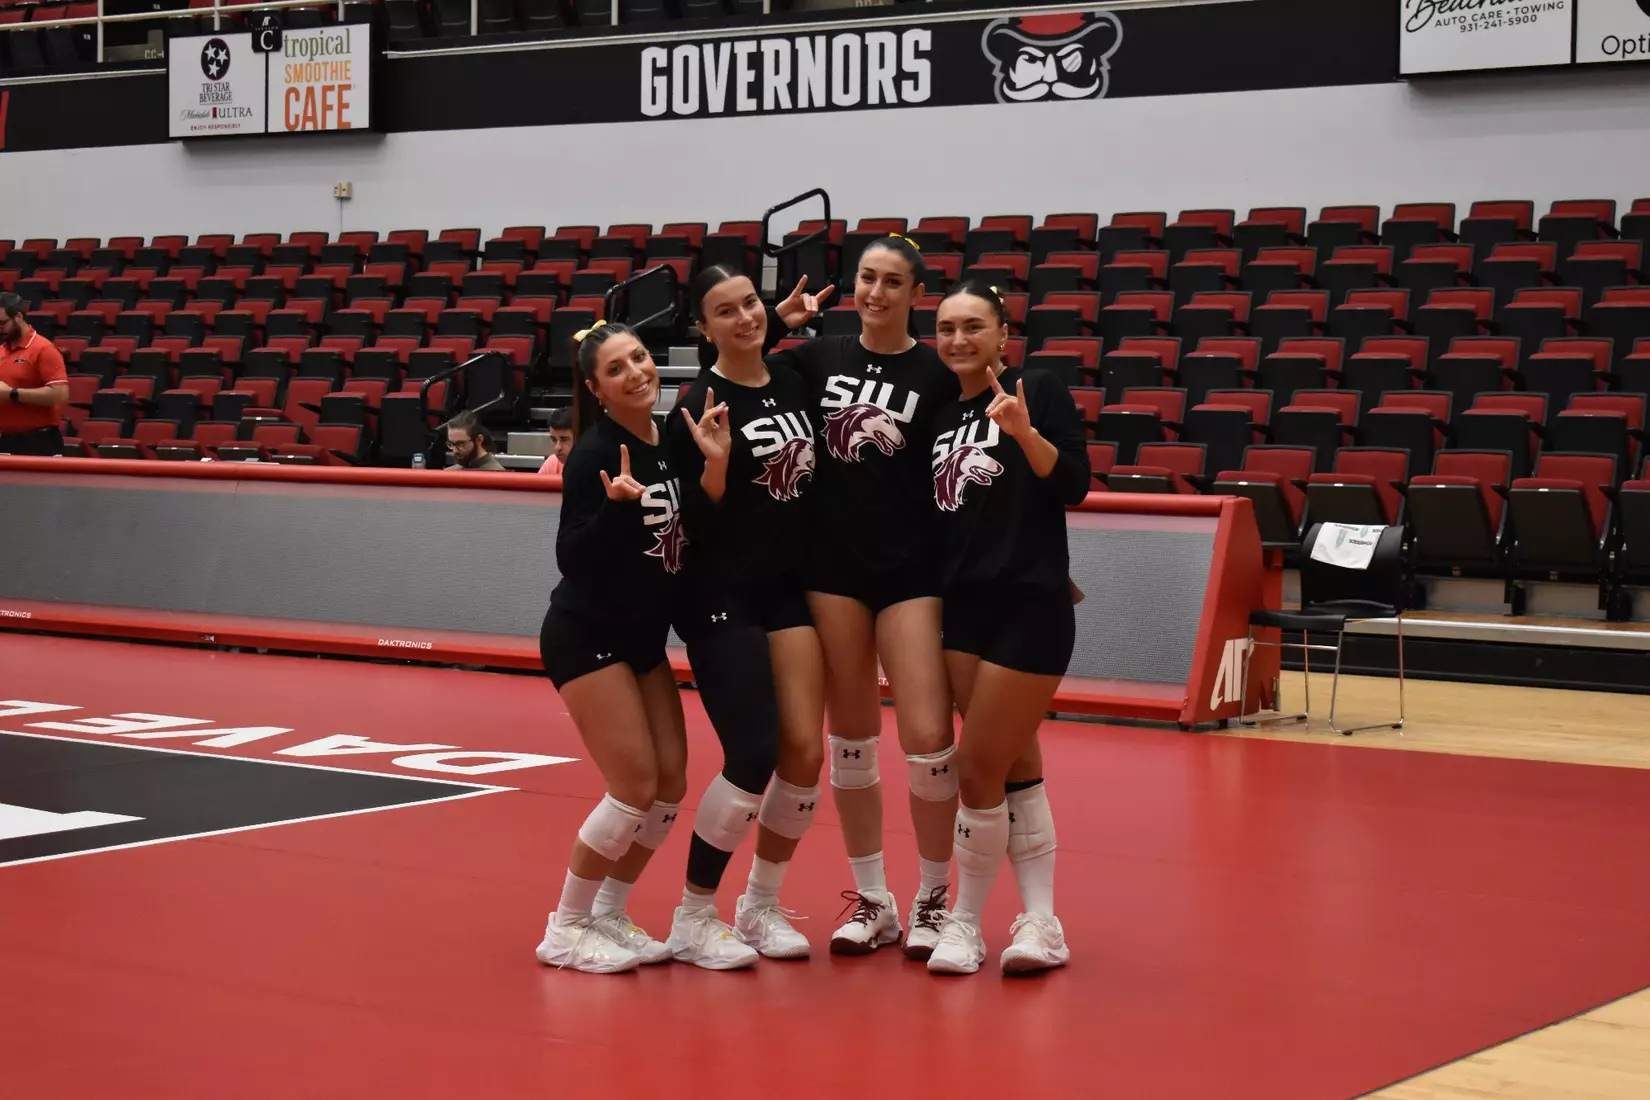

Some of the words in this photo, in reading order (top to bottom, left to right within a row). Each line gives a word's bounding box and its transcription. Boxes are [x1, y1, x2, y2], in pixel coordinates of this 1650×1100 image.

[1435, 16, 1467, 28] AUTO
[1471, 10, 1503, 22] CARE
[1514, 1, 1565, 15] TOWING
[1460, 14, 1538, 33] 931-241-5900
[260, 30, 274, 51] C
[284, 28, 352, 61] tropical
[1601, 33, 1650, 59] Opti
[284, 60, 352, 84] SMOOTHIE
[641, 28, 932, 117] GOVERNORS
[199, 91, 232, 103] BEVERAGE
[201, 83, 213, 93] TRI
[213, 82, 230, 92] STAR
[218, 107, 253, 119] ULTRA
[284, 83, 352, 131] CAFE
[820, 375, 921, 424] SIU
[740, 410, 815, 458] SIU
[931, 417, 1000, 471] SIU
[640, 477, 681, 526] SI
[378, 638, 433, 650] DAKTRONICS
